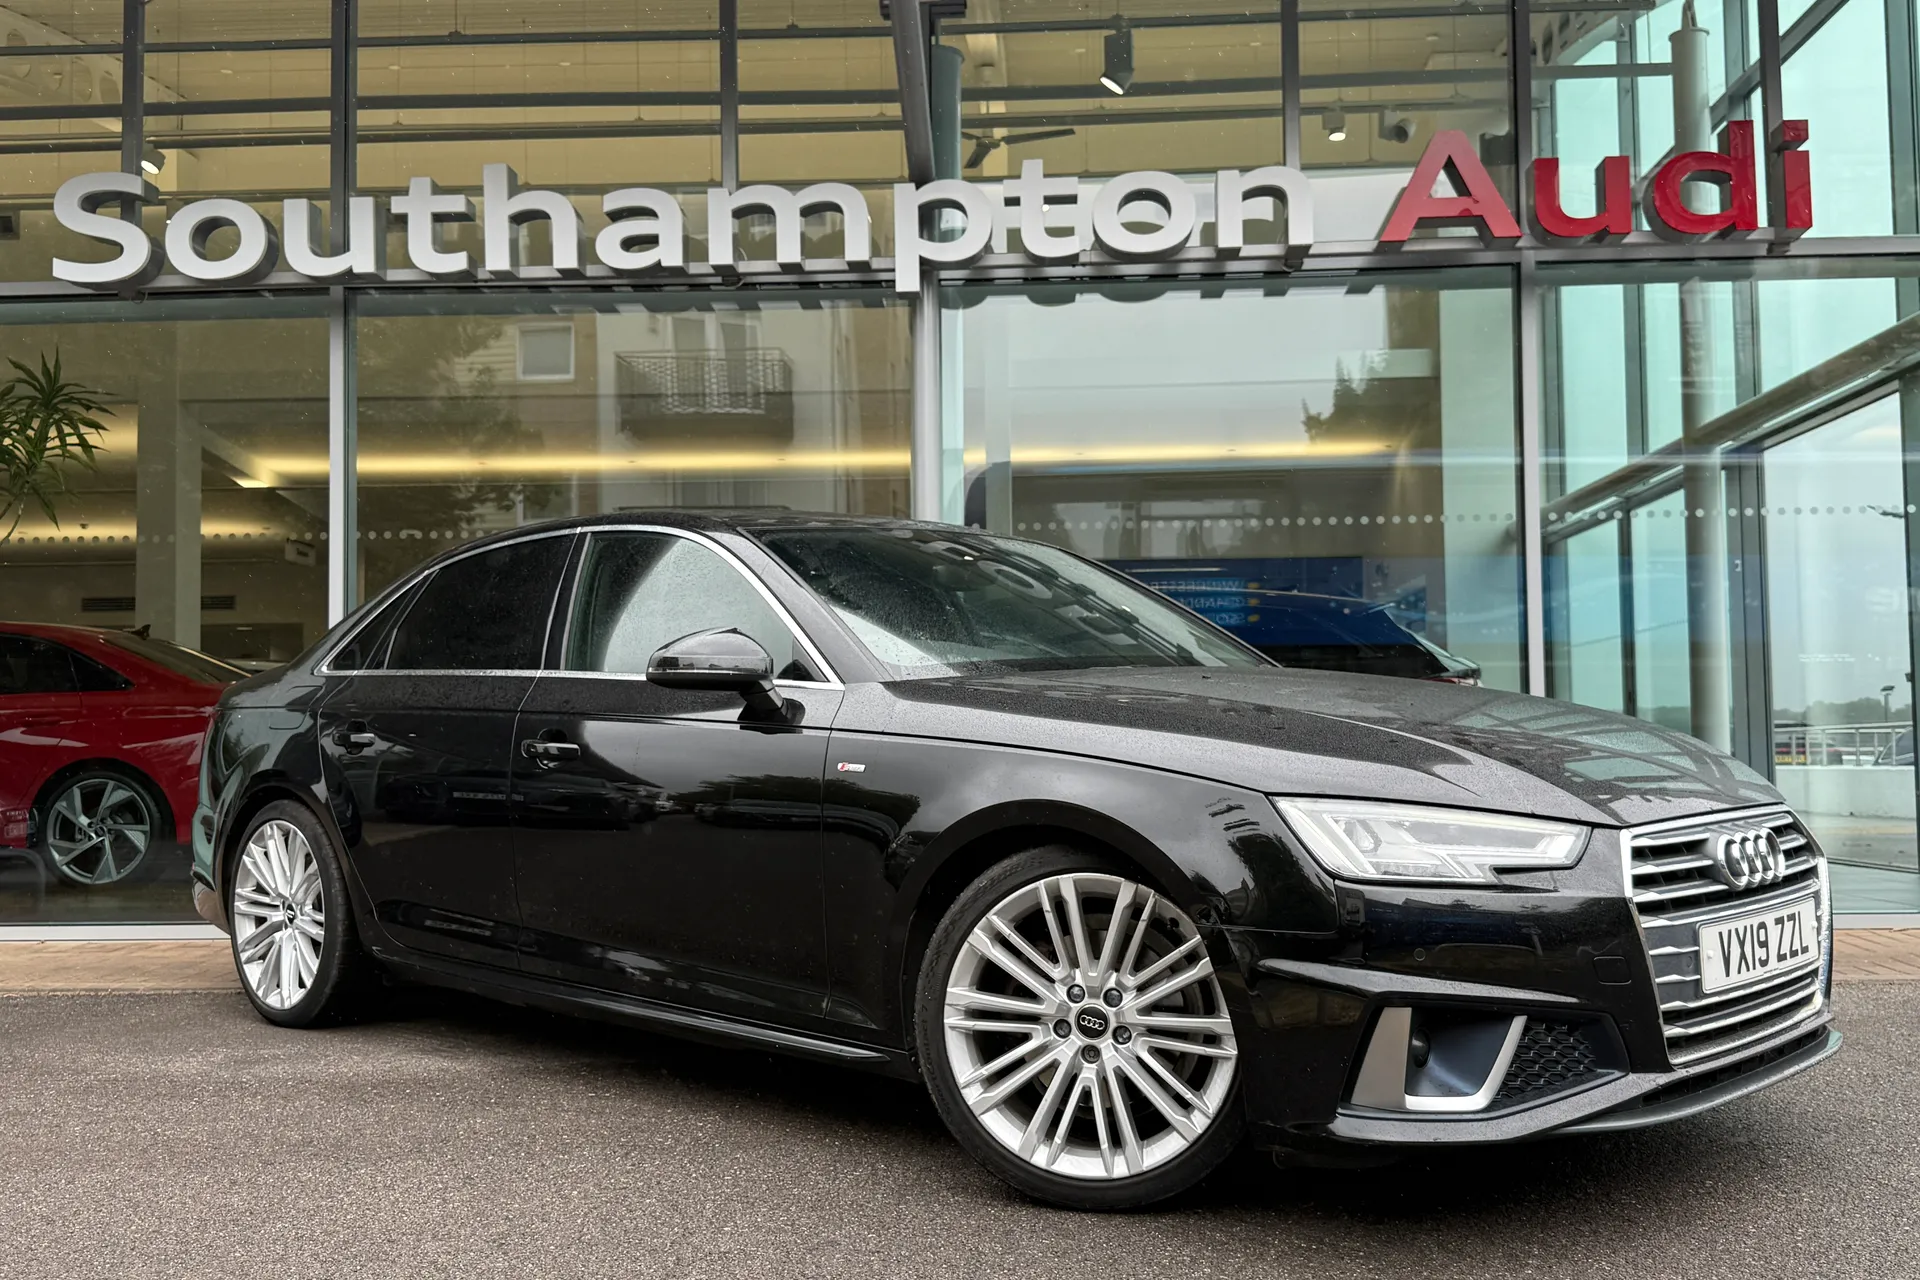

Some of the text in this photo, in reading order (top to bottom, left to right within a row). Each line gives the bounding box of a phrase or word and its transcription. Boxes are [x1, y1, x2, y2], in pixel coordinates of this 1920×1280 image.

[52, 119, 1814, 293] Southampton Audi
[1718, 910, 1809, 978] VX19 ZZL
